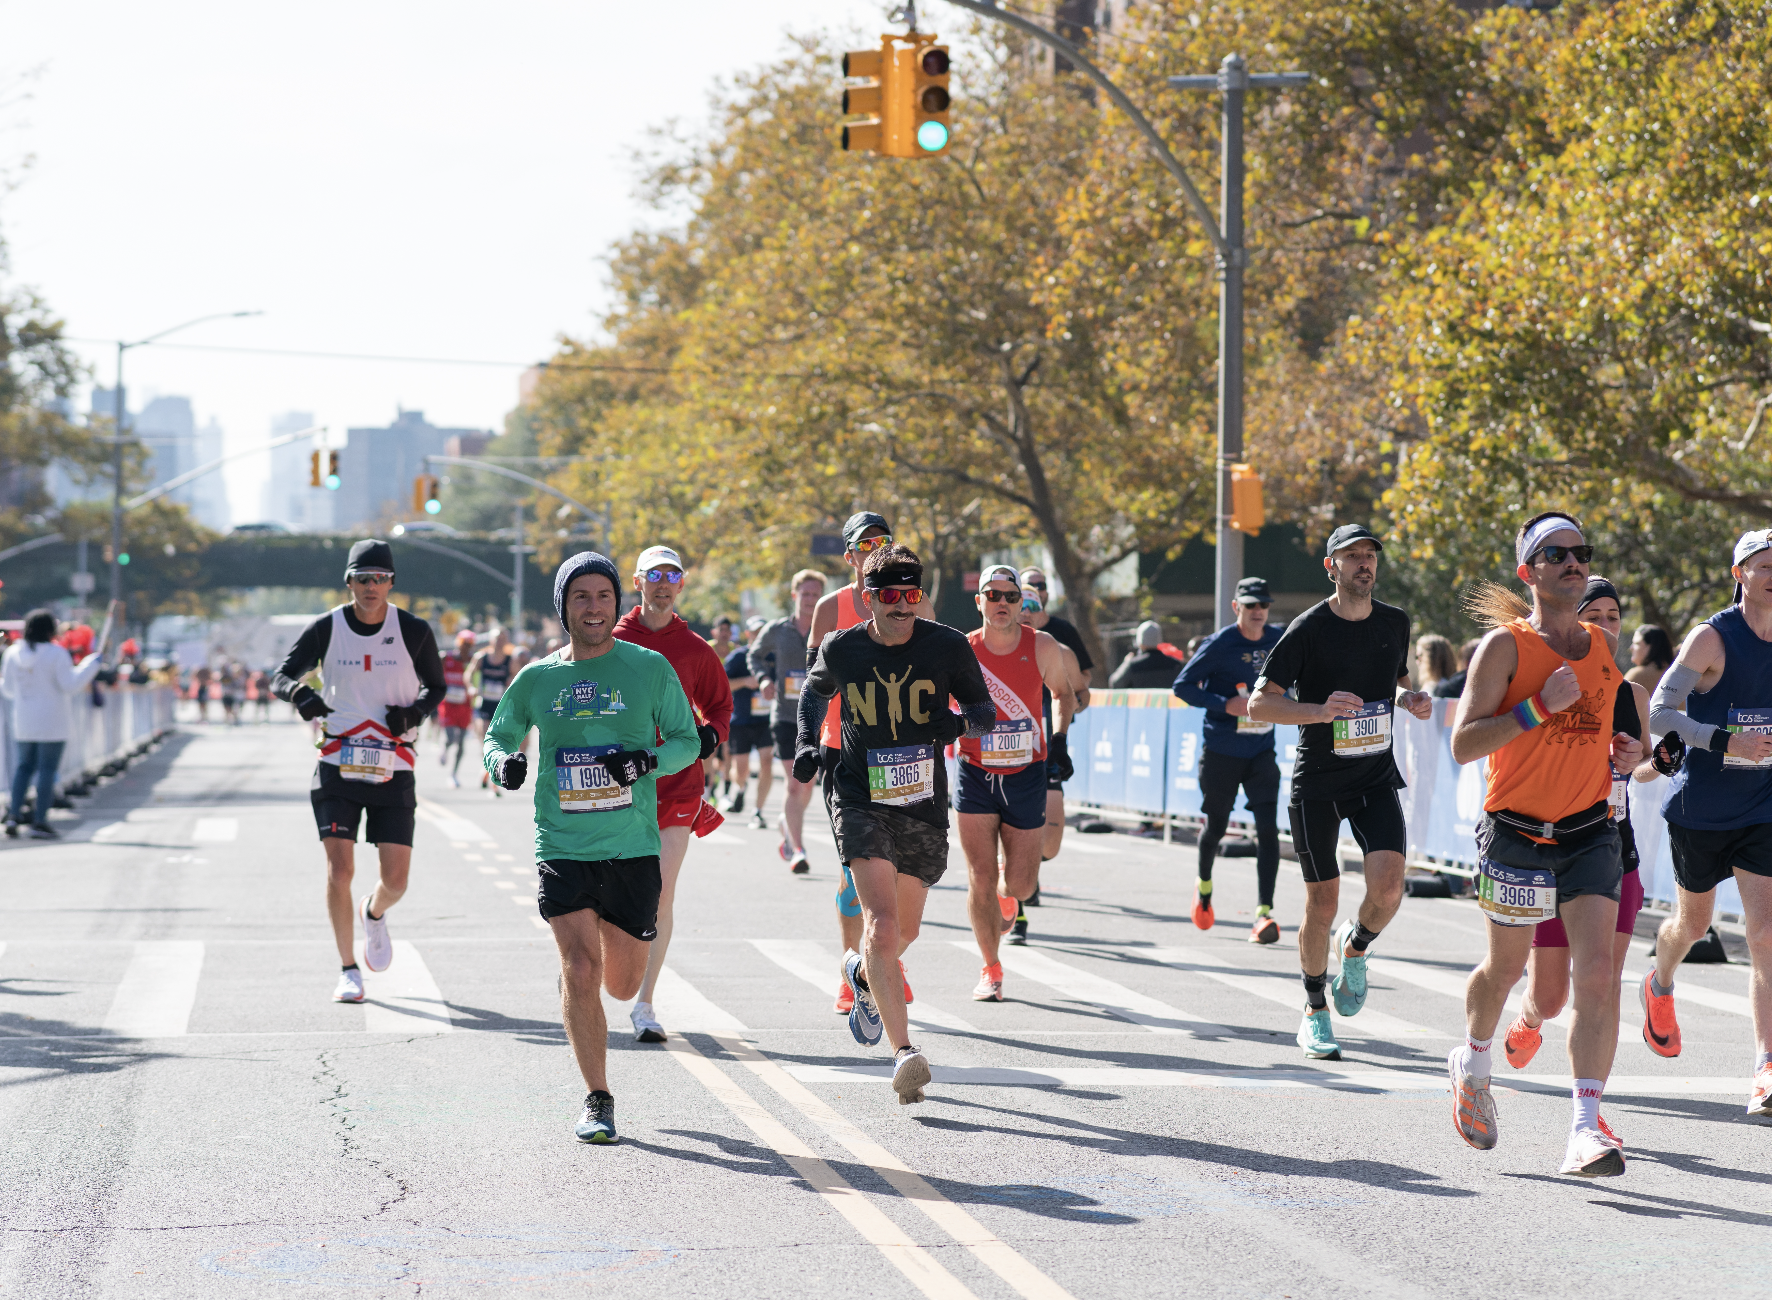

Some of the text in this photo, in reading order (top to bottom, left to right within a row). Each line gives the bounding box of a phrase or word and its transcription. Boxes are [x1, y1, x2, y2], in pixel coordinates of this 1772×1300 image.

[576, 687, 592, 695] NYC
[1738, 712, 1753, 722] tcs
[1355, 718, 1377, 737] 3901
[998, 734, 1021, 750] 2007
[1342, 731, 1346, 739] C
[361, 749, 380, 765] 3110
[563, 751, 580, 764] tcs
[877, 753, 893, 763] tcs
[580, 766, 610, 788] 1909
[891, 764, 919, 787] 3866
[565, 779, 571, 790] B
[1488, 864, 1505, 880] tcs
[1485, 889, 1491, 900] C
[1500, 885, 1535, 907] 3968
